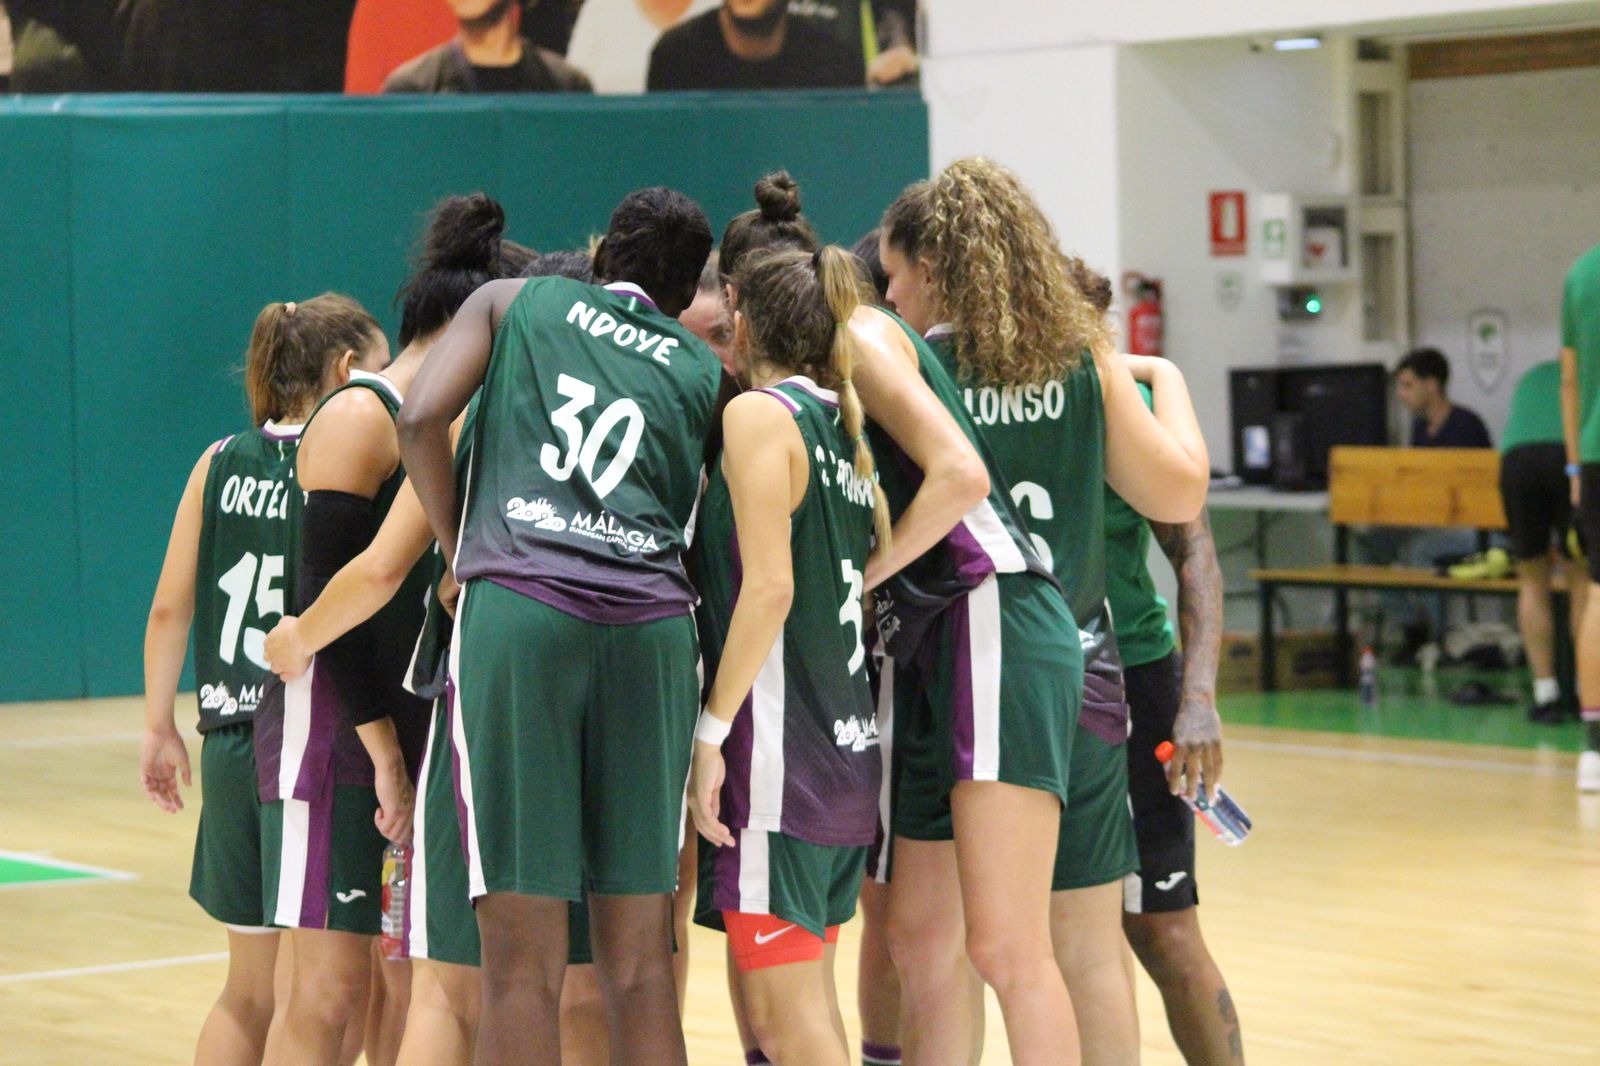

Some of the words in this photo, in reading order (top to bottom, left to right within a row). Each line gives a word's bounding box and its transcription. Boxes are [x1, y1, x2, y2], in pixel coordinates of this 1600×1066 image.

[566, 301, 679, 366] NDOYE
[957, 380, 1065, 425] LONSO
[540, 373, 645, 499] 30
[570, 510, 660, 551] MÁLAGA
[218, 551, 284, 671] 15
